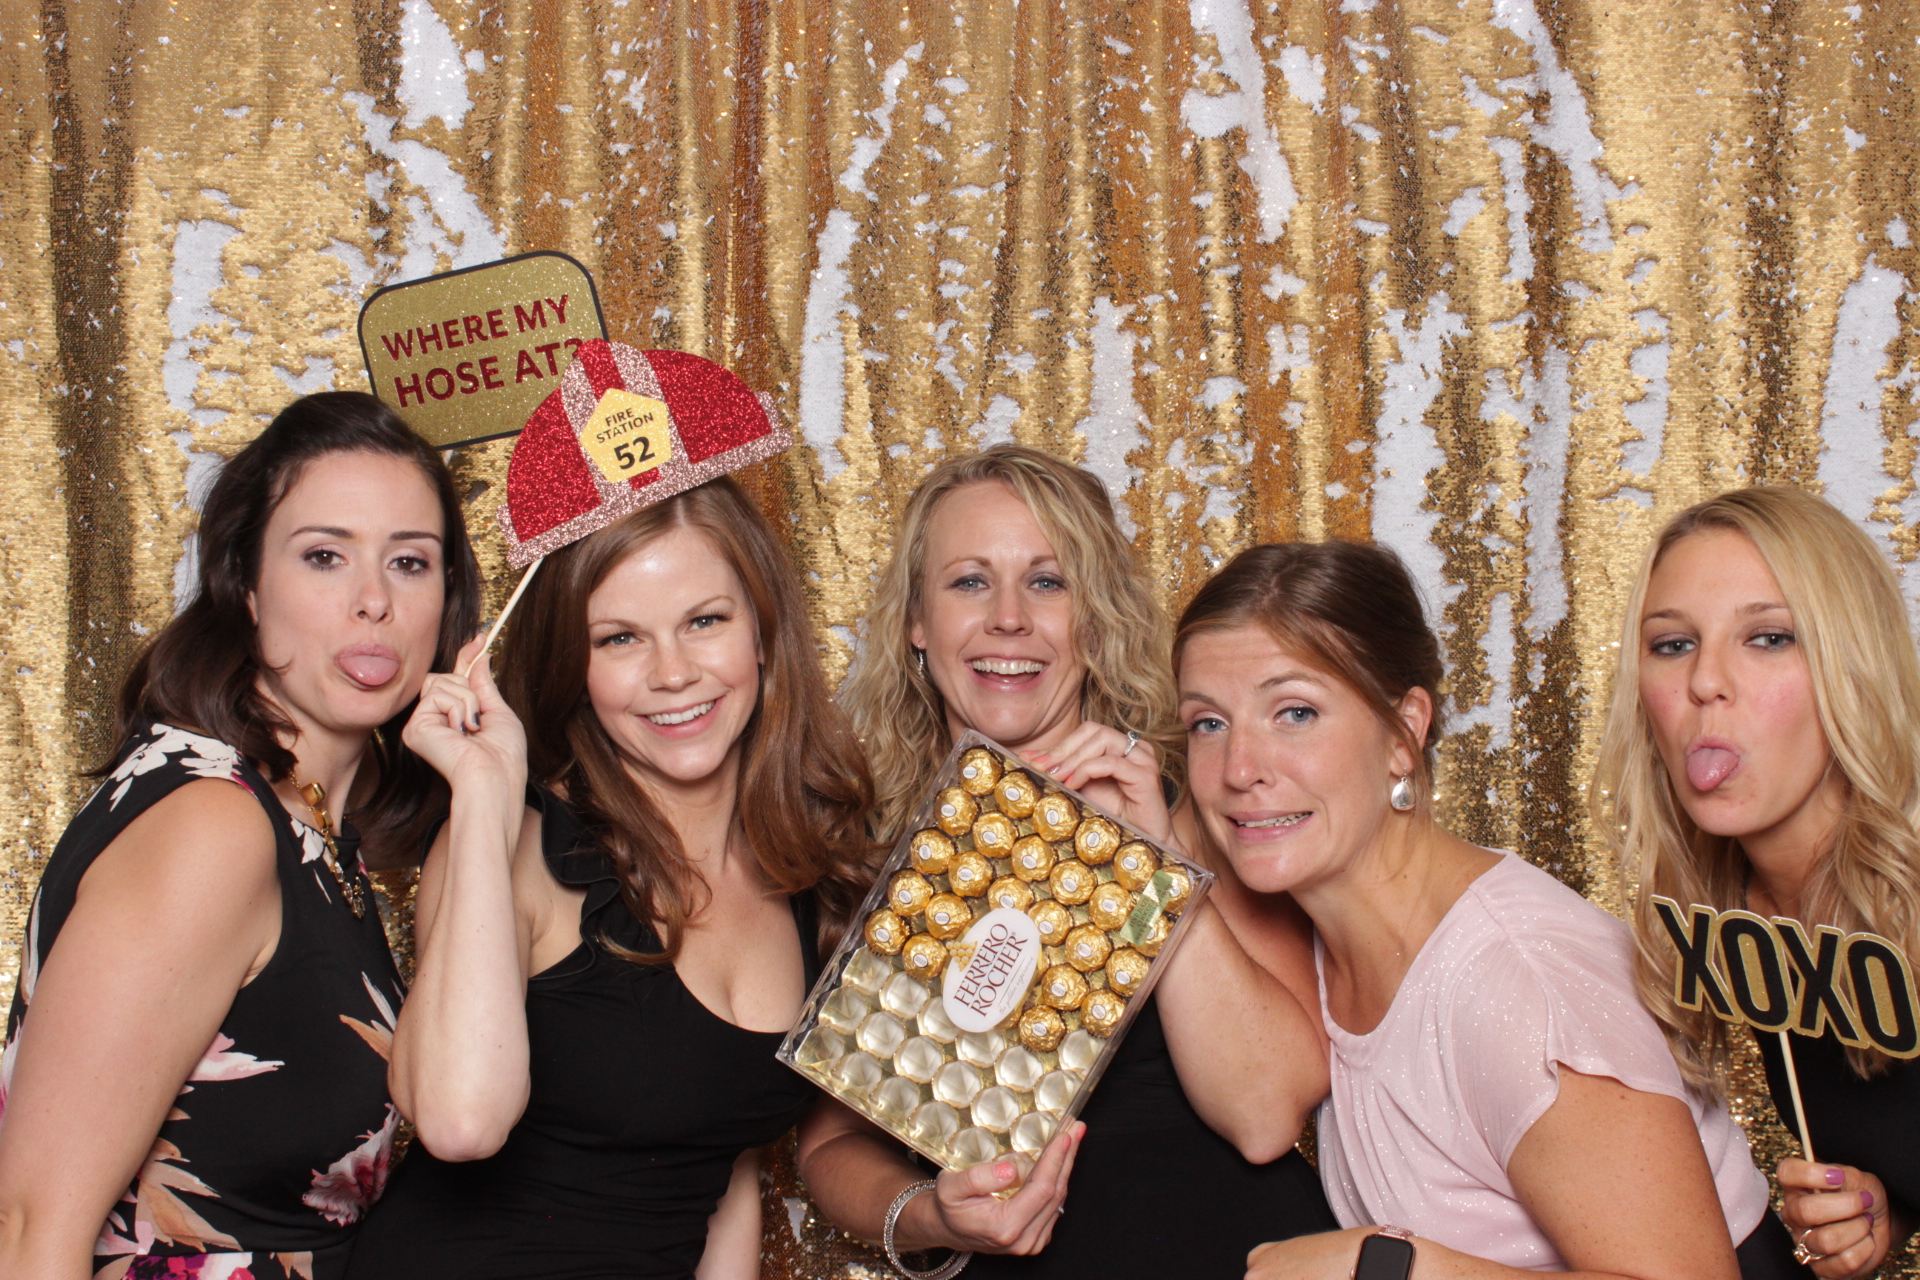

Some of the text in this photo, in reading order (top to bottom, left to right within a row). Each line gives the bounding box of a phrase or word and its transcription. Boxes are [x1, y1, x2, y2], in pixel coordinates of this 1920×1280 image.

[381, 294, 569, 361] WHERE MY
[394, 356, 504, 408] HOSE
[596, 412, 654, 444] STATION
[605, 407, 634, 427] FIRE
[614, 436, 656, 470] 52
[953, 923, 1009, 1007] FERRERO
[970, 935, 1028, 1017] ROCHER
[1653, 901, 1918, 1053] XOXO
